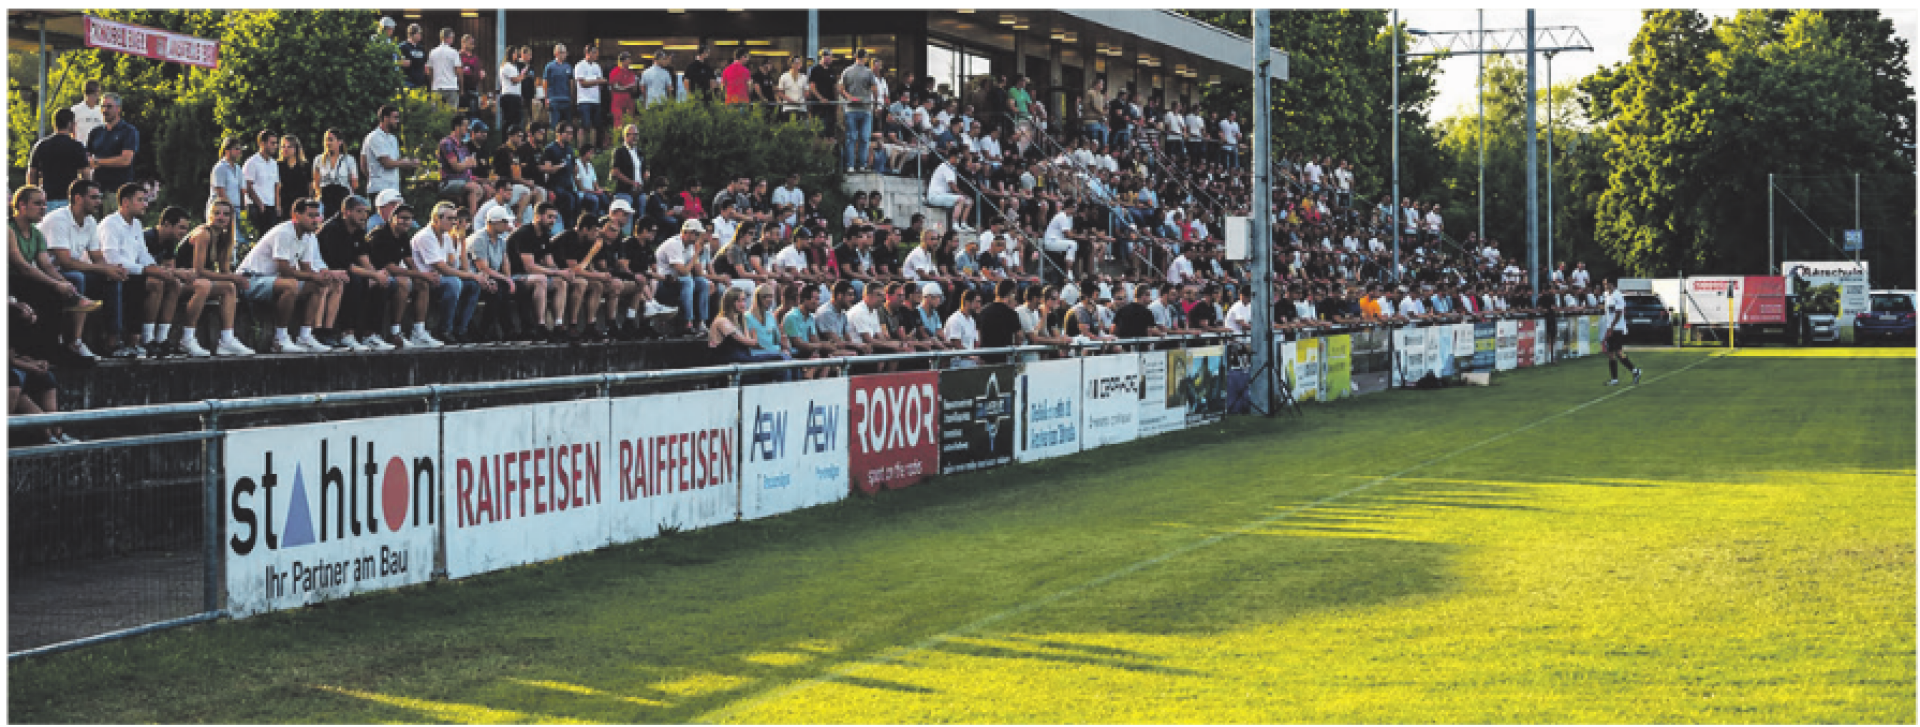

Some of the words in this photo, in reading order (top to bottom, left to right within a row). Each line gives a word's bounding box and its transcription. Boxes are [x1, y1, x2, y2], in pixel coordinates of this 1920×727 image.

[750, 404, 788, 463] AEW
[804, 399, 839, 455] AEW
[856, 383, 935, 454] ROXOR
[456, 441, 600, 529] RAIFFEISEN
[619, 427, 735, 502] RAIFFEISEN
[265, 565, 288, 599] Ihr
[292, 559, 350, 595] Partner
[353, 555, 376, 582] am
[379, 545, 408, 578] Bau
